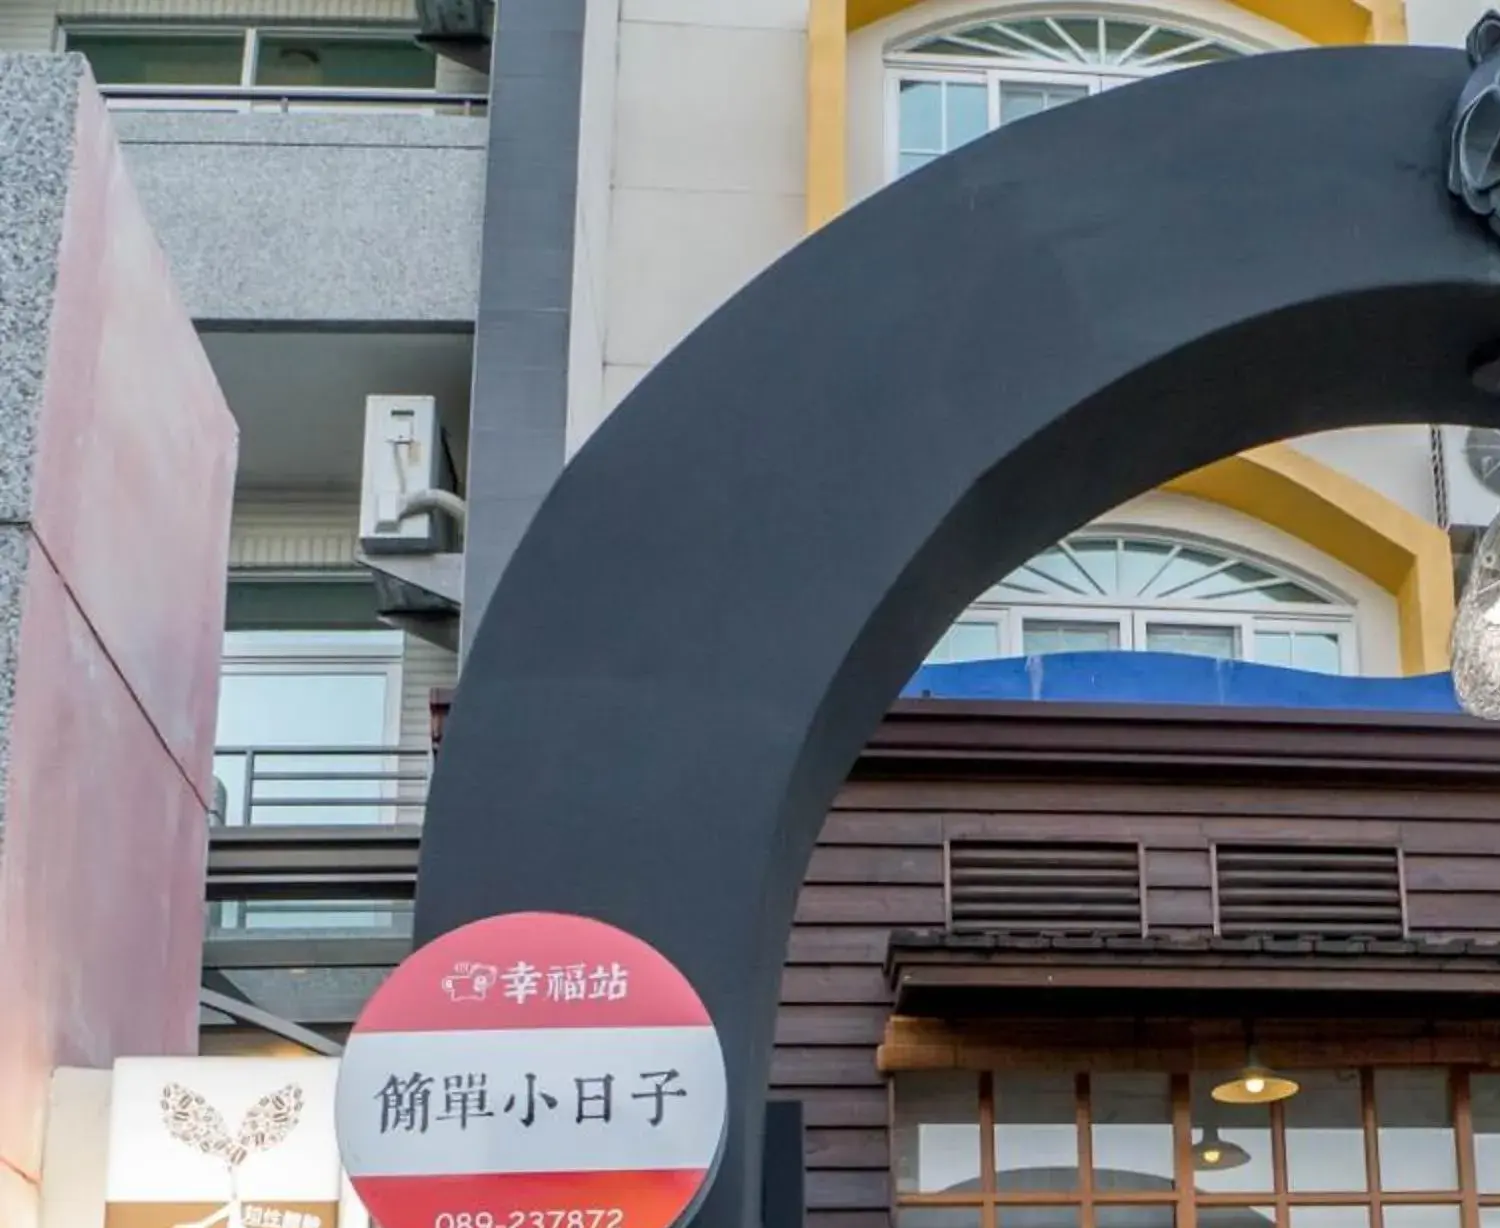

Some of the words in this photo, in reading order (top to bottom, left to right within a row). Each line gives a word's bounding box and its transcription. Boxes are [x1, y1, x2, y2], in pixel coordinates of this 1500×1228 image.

[500, 960, 629, 1004] 幸福站
[373, 1069, 688, 1134] 簡單小日子
